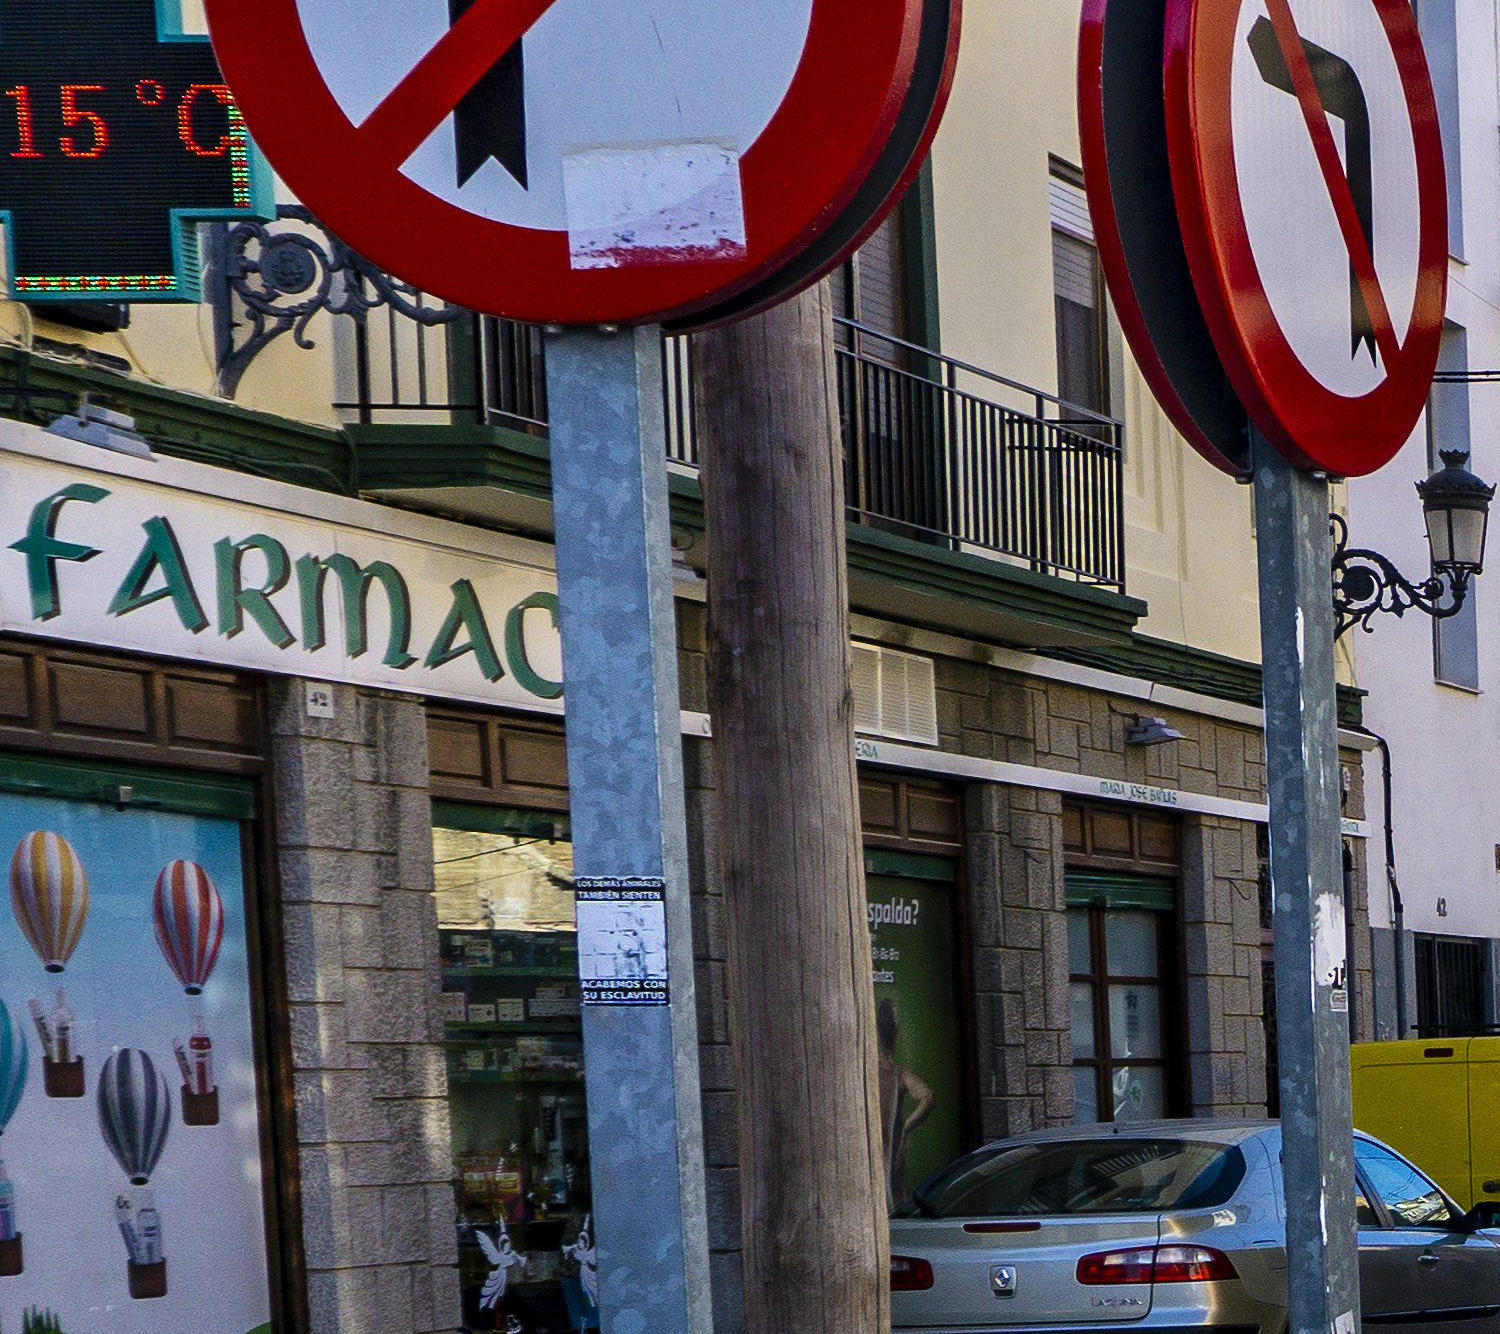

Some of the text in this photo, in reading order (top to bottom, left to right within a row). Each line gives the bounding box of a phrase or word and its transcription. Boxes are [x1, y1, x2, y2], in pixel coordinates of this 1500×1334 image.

[5, 85, 109, 158] 15
[7, 482, 564, 699] FARMAC
[621, 891, 661, 900] SIENTEN
[867, 897, 919, 930] spalda?
[581, 980, 667, 989] ACABEMOS CON
[582, 990, 666, 1000] SU ESCLAVITUD
